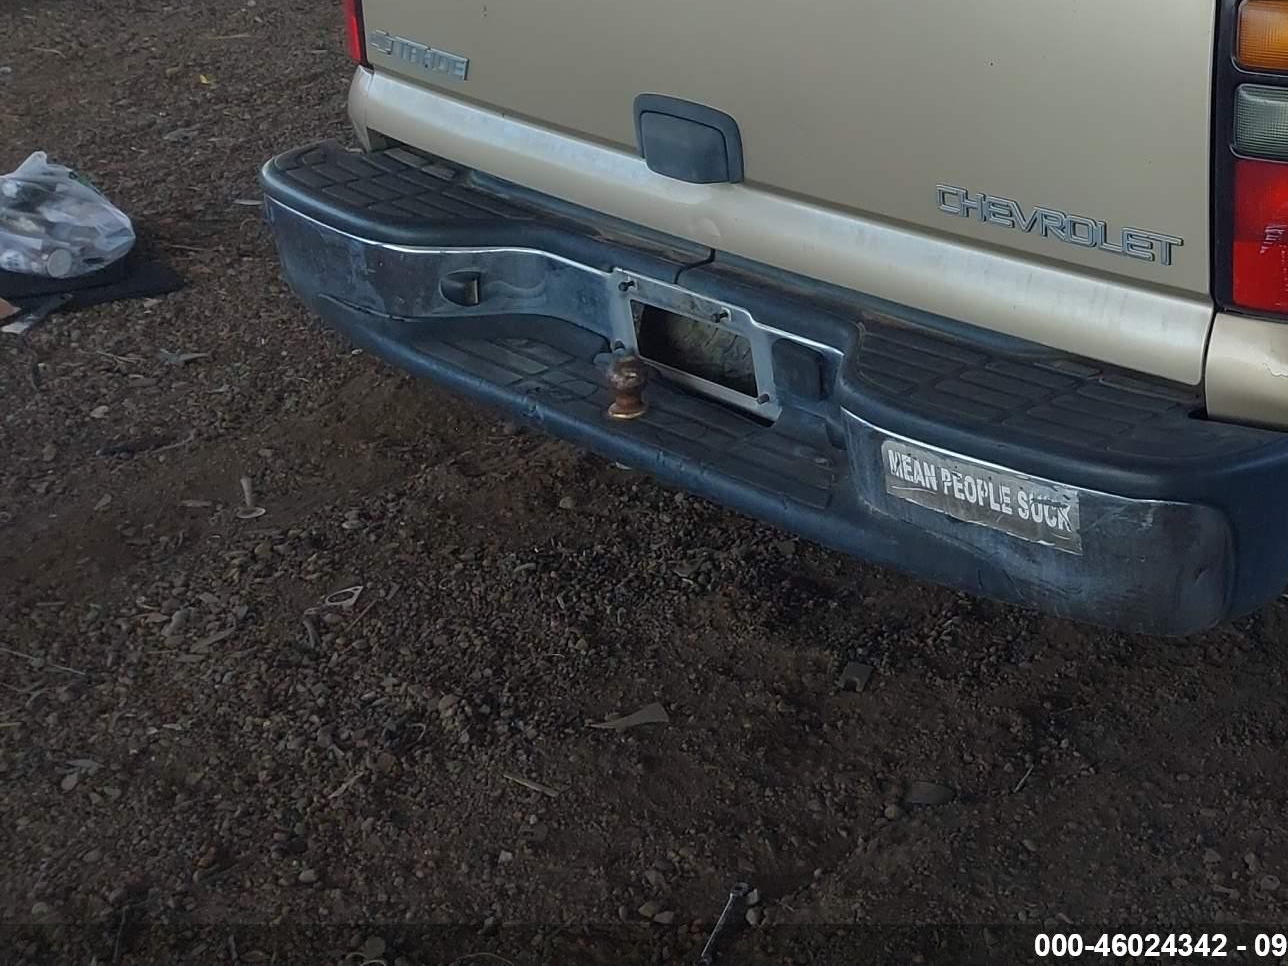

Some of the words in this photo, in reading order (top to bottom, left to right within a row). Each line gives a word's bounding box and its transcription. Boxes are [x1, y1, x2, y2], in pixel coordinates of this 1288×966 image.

[935, 183, 1184, 266] CHEVROLET
[888, 449, 938, 491] MEAN
[940, 467, 1013, 515] PEOPLE
[1017, 489, 1073, 533] SUCK
